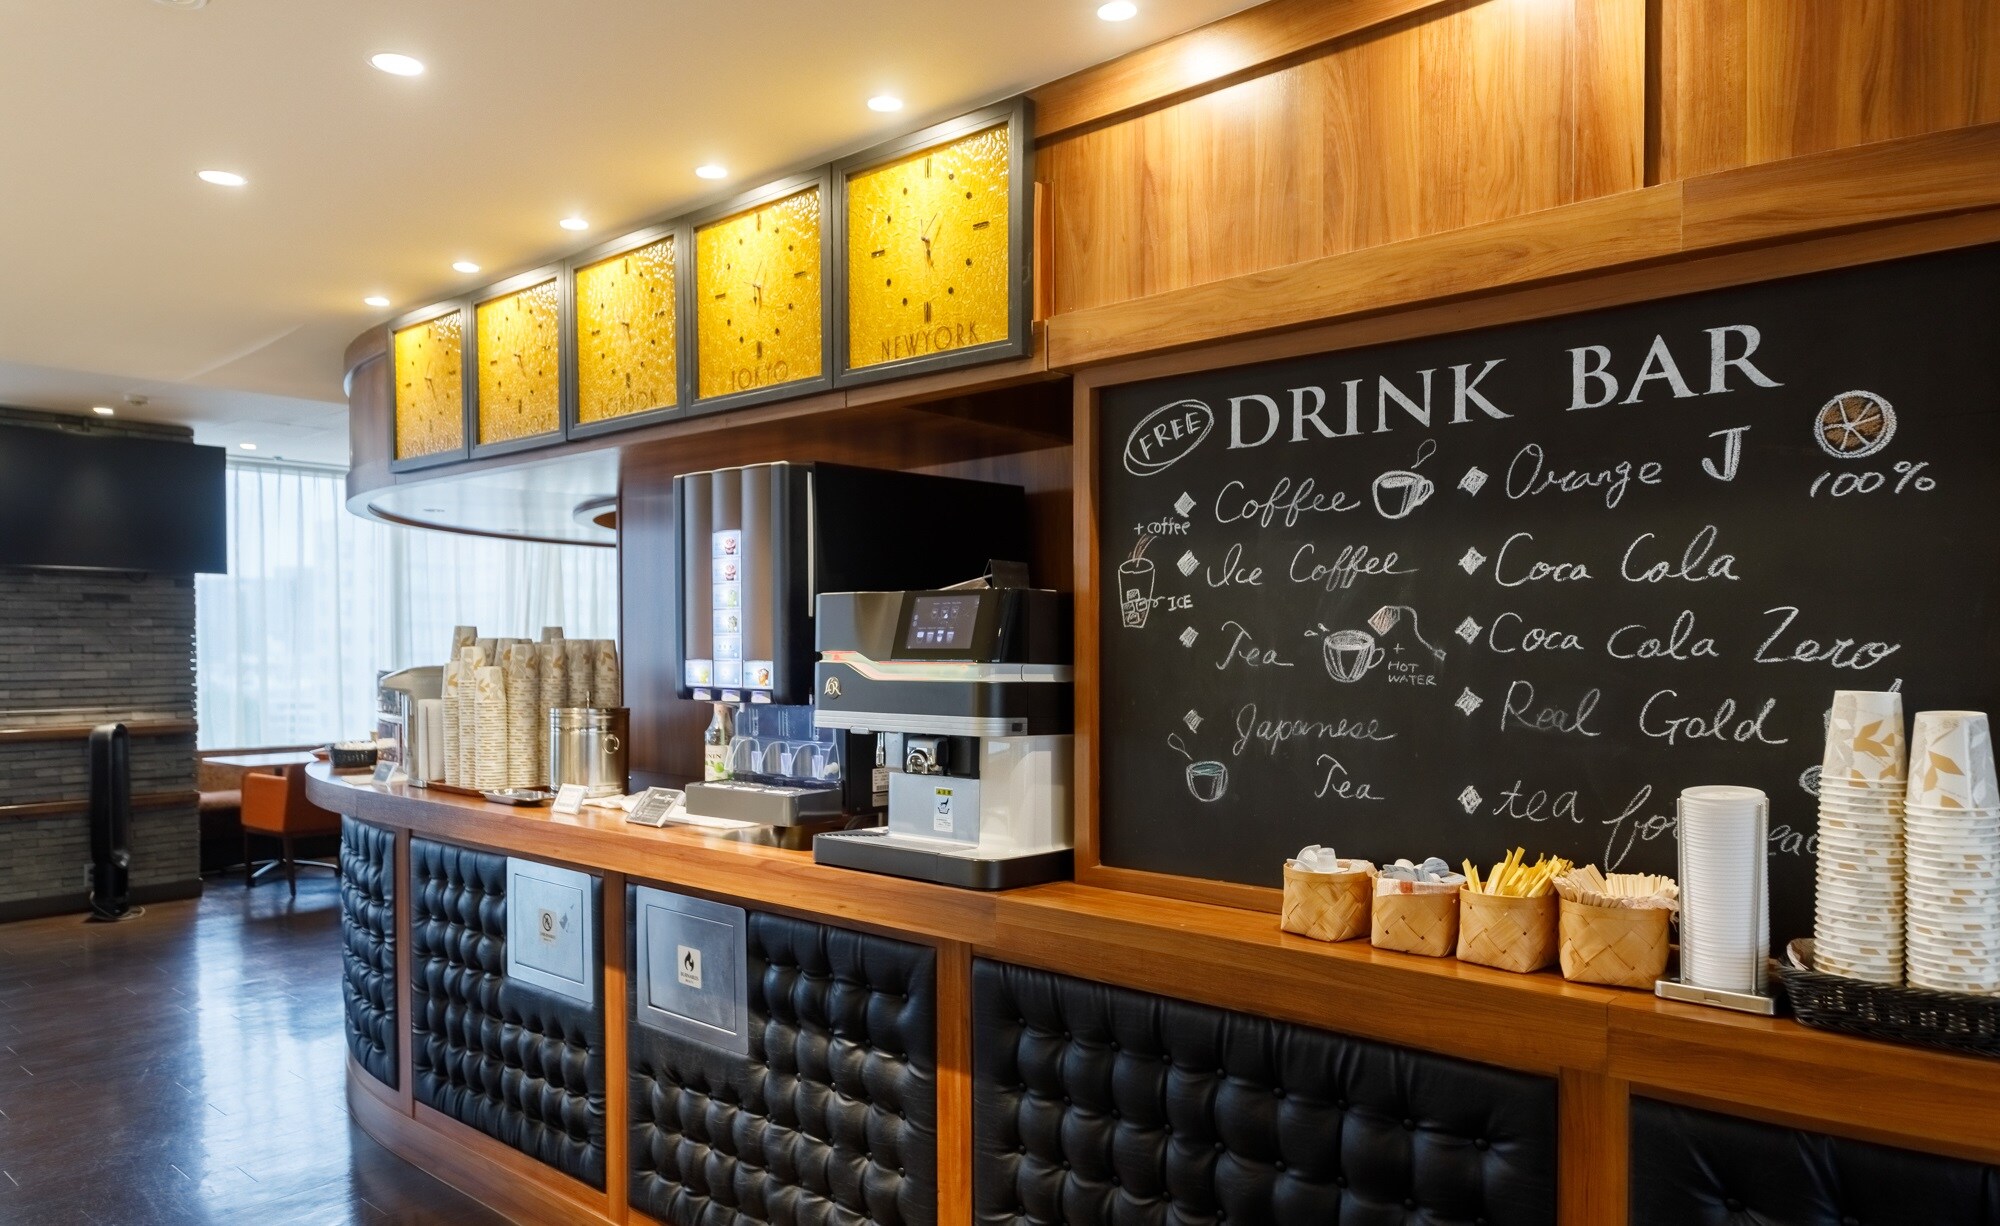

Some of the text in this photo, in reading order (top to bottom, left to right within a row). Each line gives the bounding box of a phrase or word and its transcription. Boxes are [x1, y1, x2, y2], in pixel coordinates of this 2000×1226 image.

[731, 361, 788, 391] TOKYO
[1226, 325, 1785, 449] DRINK BAR
[1139, 411, 1202, 461] FREE
[1506, 425, 1751, 509] Orange J
[1810, 461, 1936, 497] 100%
[1215, 477, 1361, 528] Coffee
[1207, 543, 1419, 592] Ice Coffee
[1495, 525, 1741, 587] Coca Cola
[1167, 594, 1193, 611] ICE
[1216, 621, 1294, 670] Tea
[1489, 612, 1584, 653] Coca
[1753, 606, 1901, 670] Zero
[1388, 661, 1419, 673] HOT
[1388, 675, 1436, 685] WATER
[1233, 703, 1396, 756] Japanese
[1501, 680, 1788, 745] Real Gold
[1314, 754, 1384, 800] Tea
[1492, 780, 1584, 823] tea
